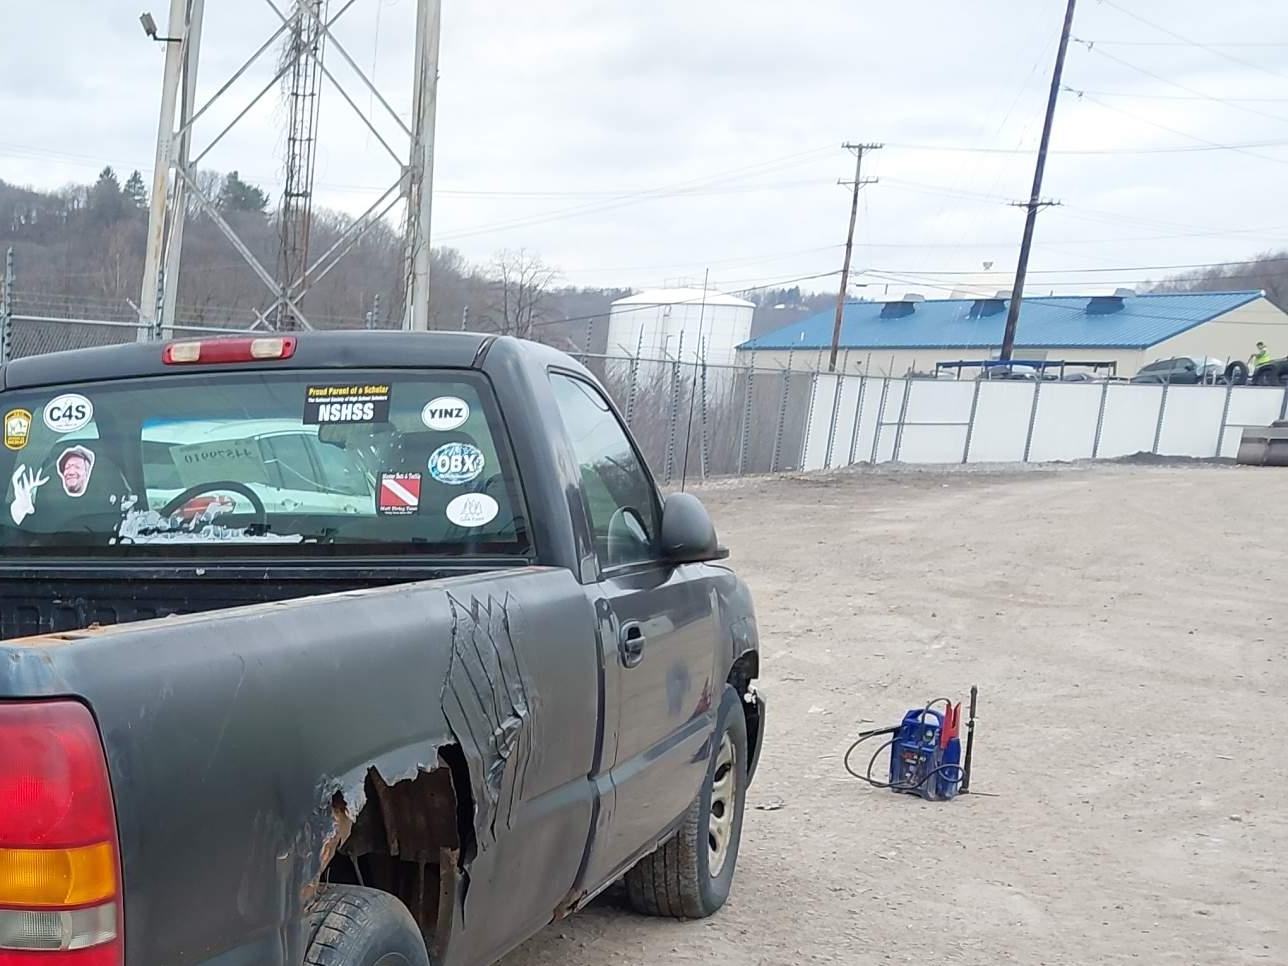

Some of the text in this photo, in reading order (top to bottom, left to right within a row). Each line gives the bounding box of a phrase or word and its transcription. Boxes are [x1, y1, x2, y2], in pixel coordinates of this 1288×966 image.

[308, 387, 328, 396] Proud
[329, 386, 349, 396] Parent
[350, 386, 358, 395] of
[364, 385, 389, 394] Scholar
[49, 404, 86, 421] C4S
[318, 403, 374, 422] NSHSS
[429, 408, 464, 419] YINZ
[437, 453, 476, 473] OBX
